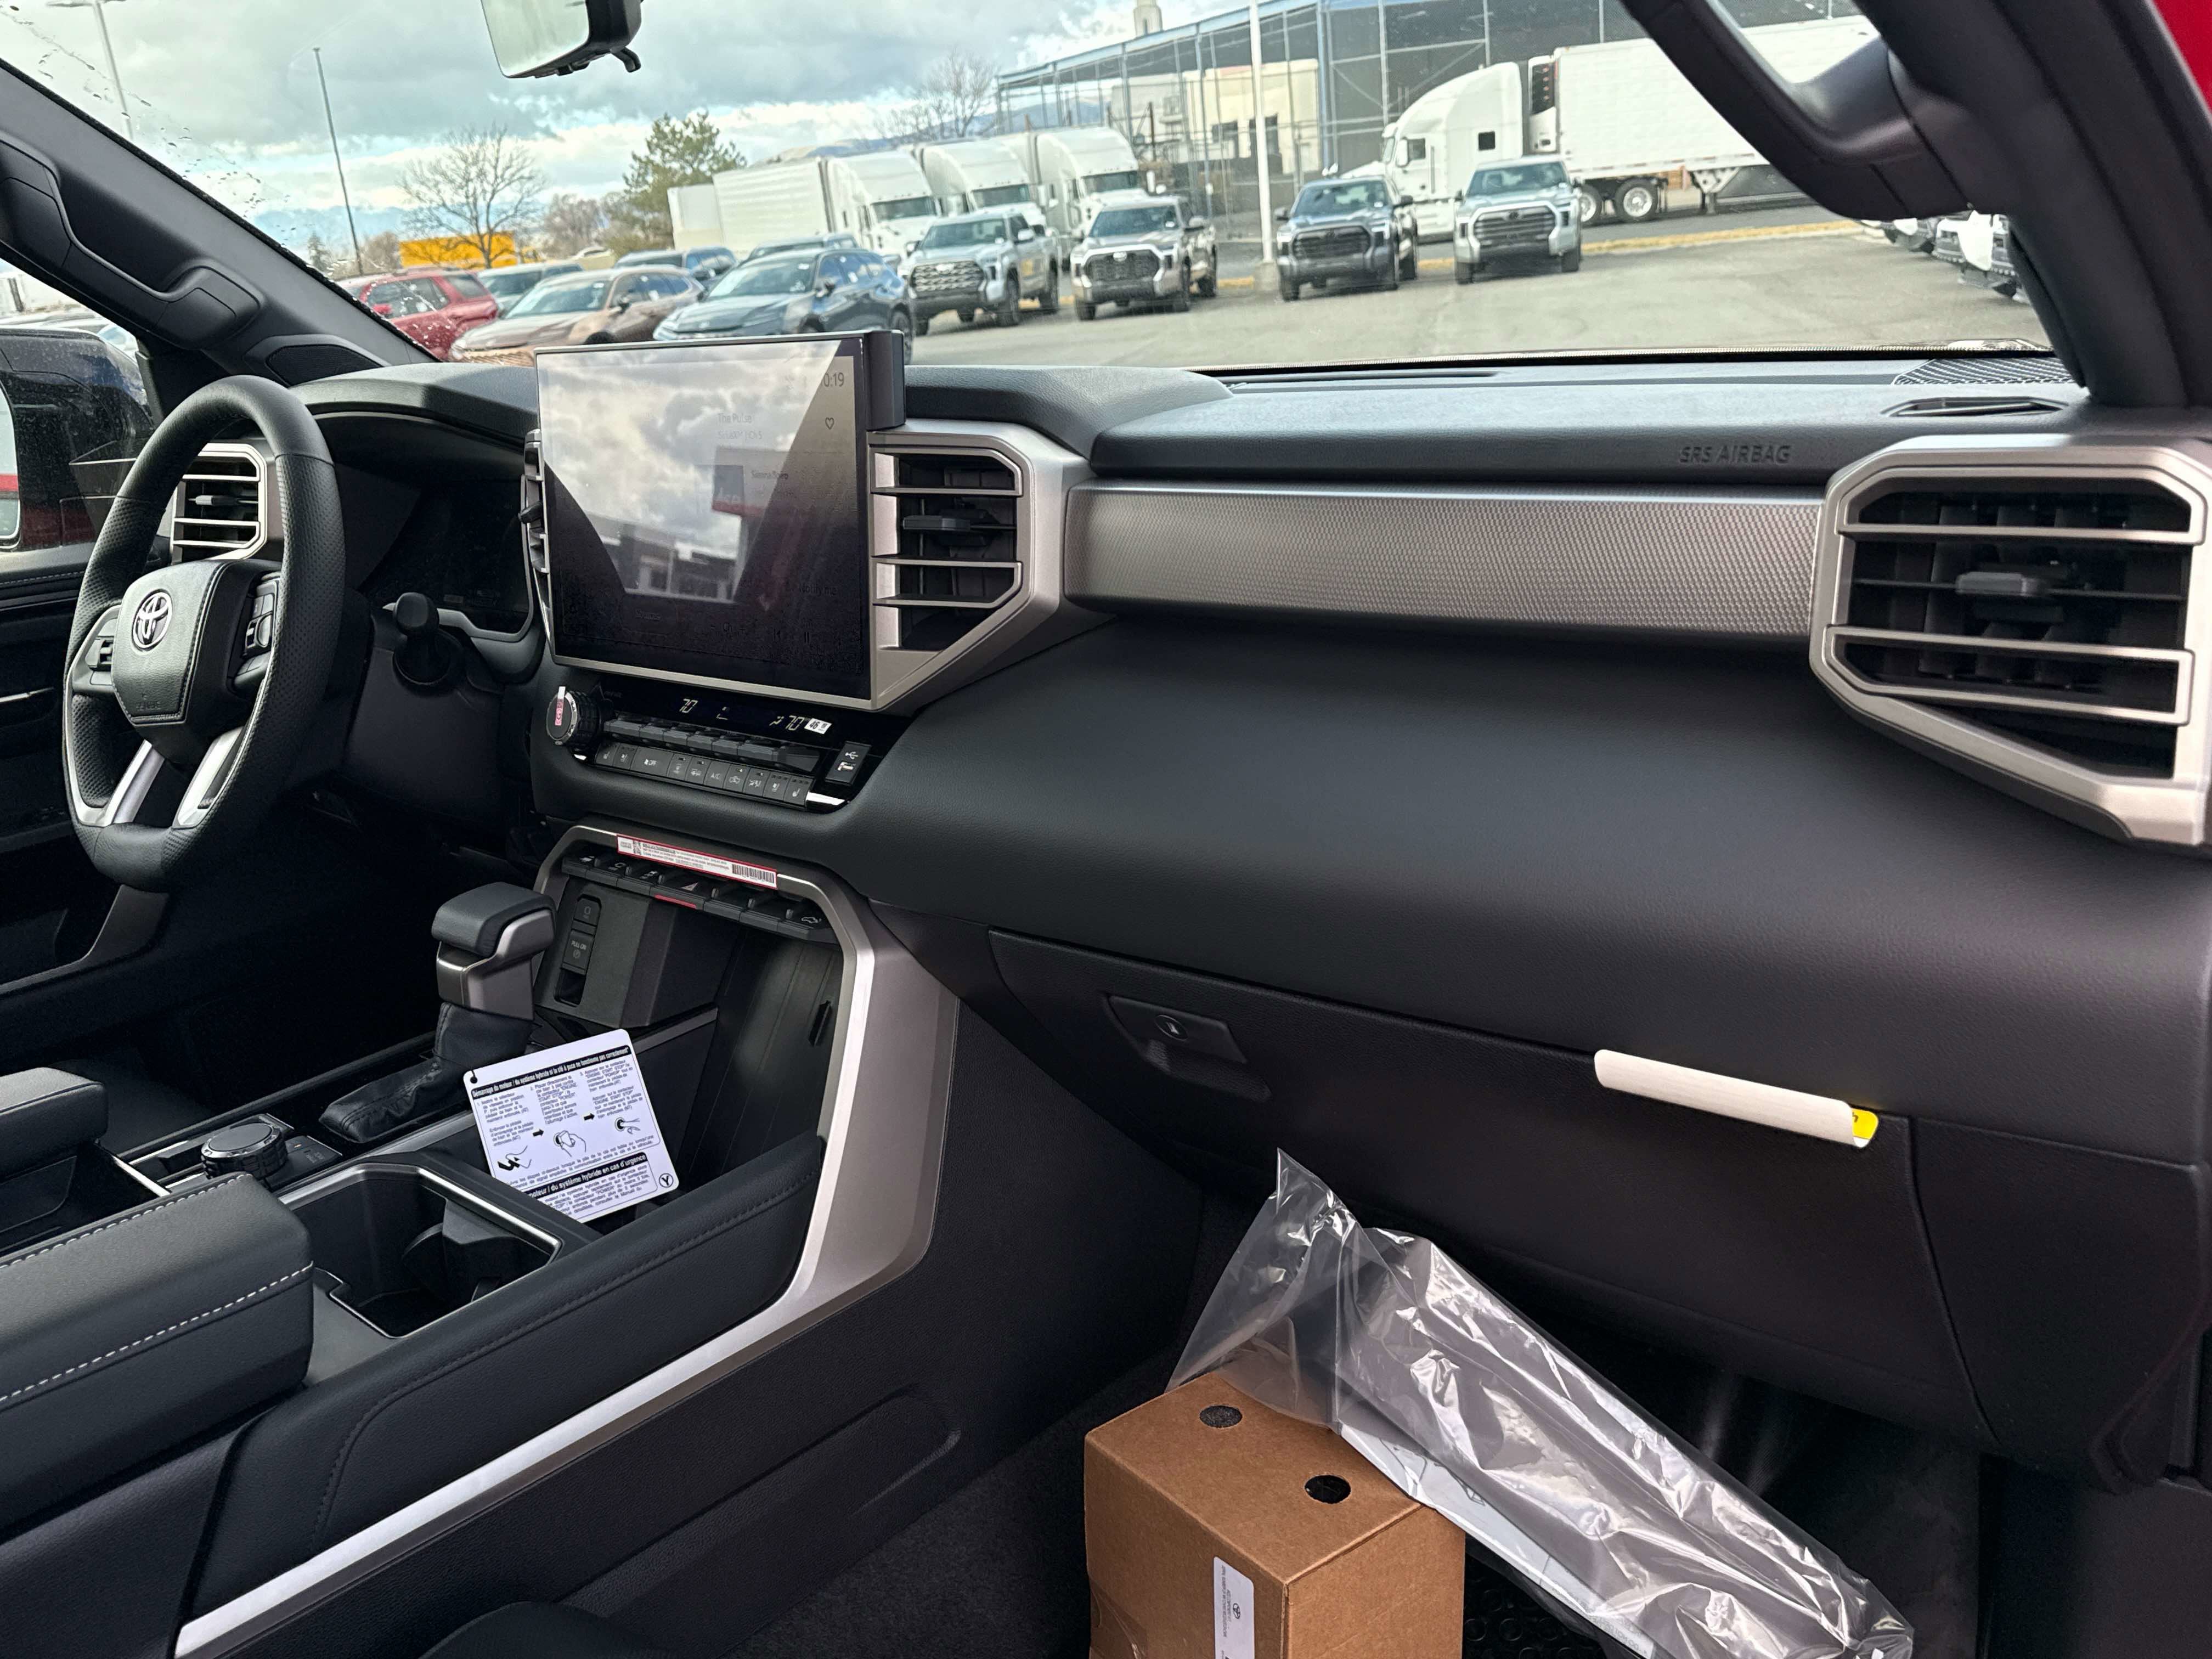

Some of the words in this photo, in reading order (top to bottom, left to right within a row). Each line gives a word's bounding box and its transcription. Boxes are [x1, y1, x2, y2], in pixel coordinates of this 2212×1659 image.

[1679, 445, 1713, 464] SRS
[1717, 444, 1791, 464] AIRBAG
[679, 698, 698, 713] 70
[786, 715, 805, 731] 70
[558, 1177, 581, 1188] système
[581, 1170, 602, 1181] hybride
[620, 1155, 646, 1167] d'urgence
[661, 1175, 672, 1187] Y
